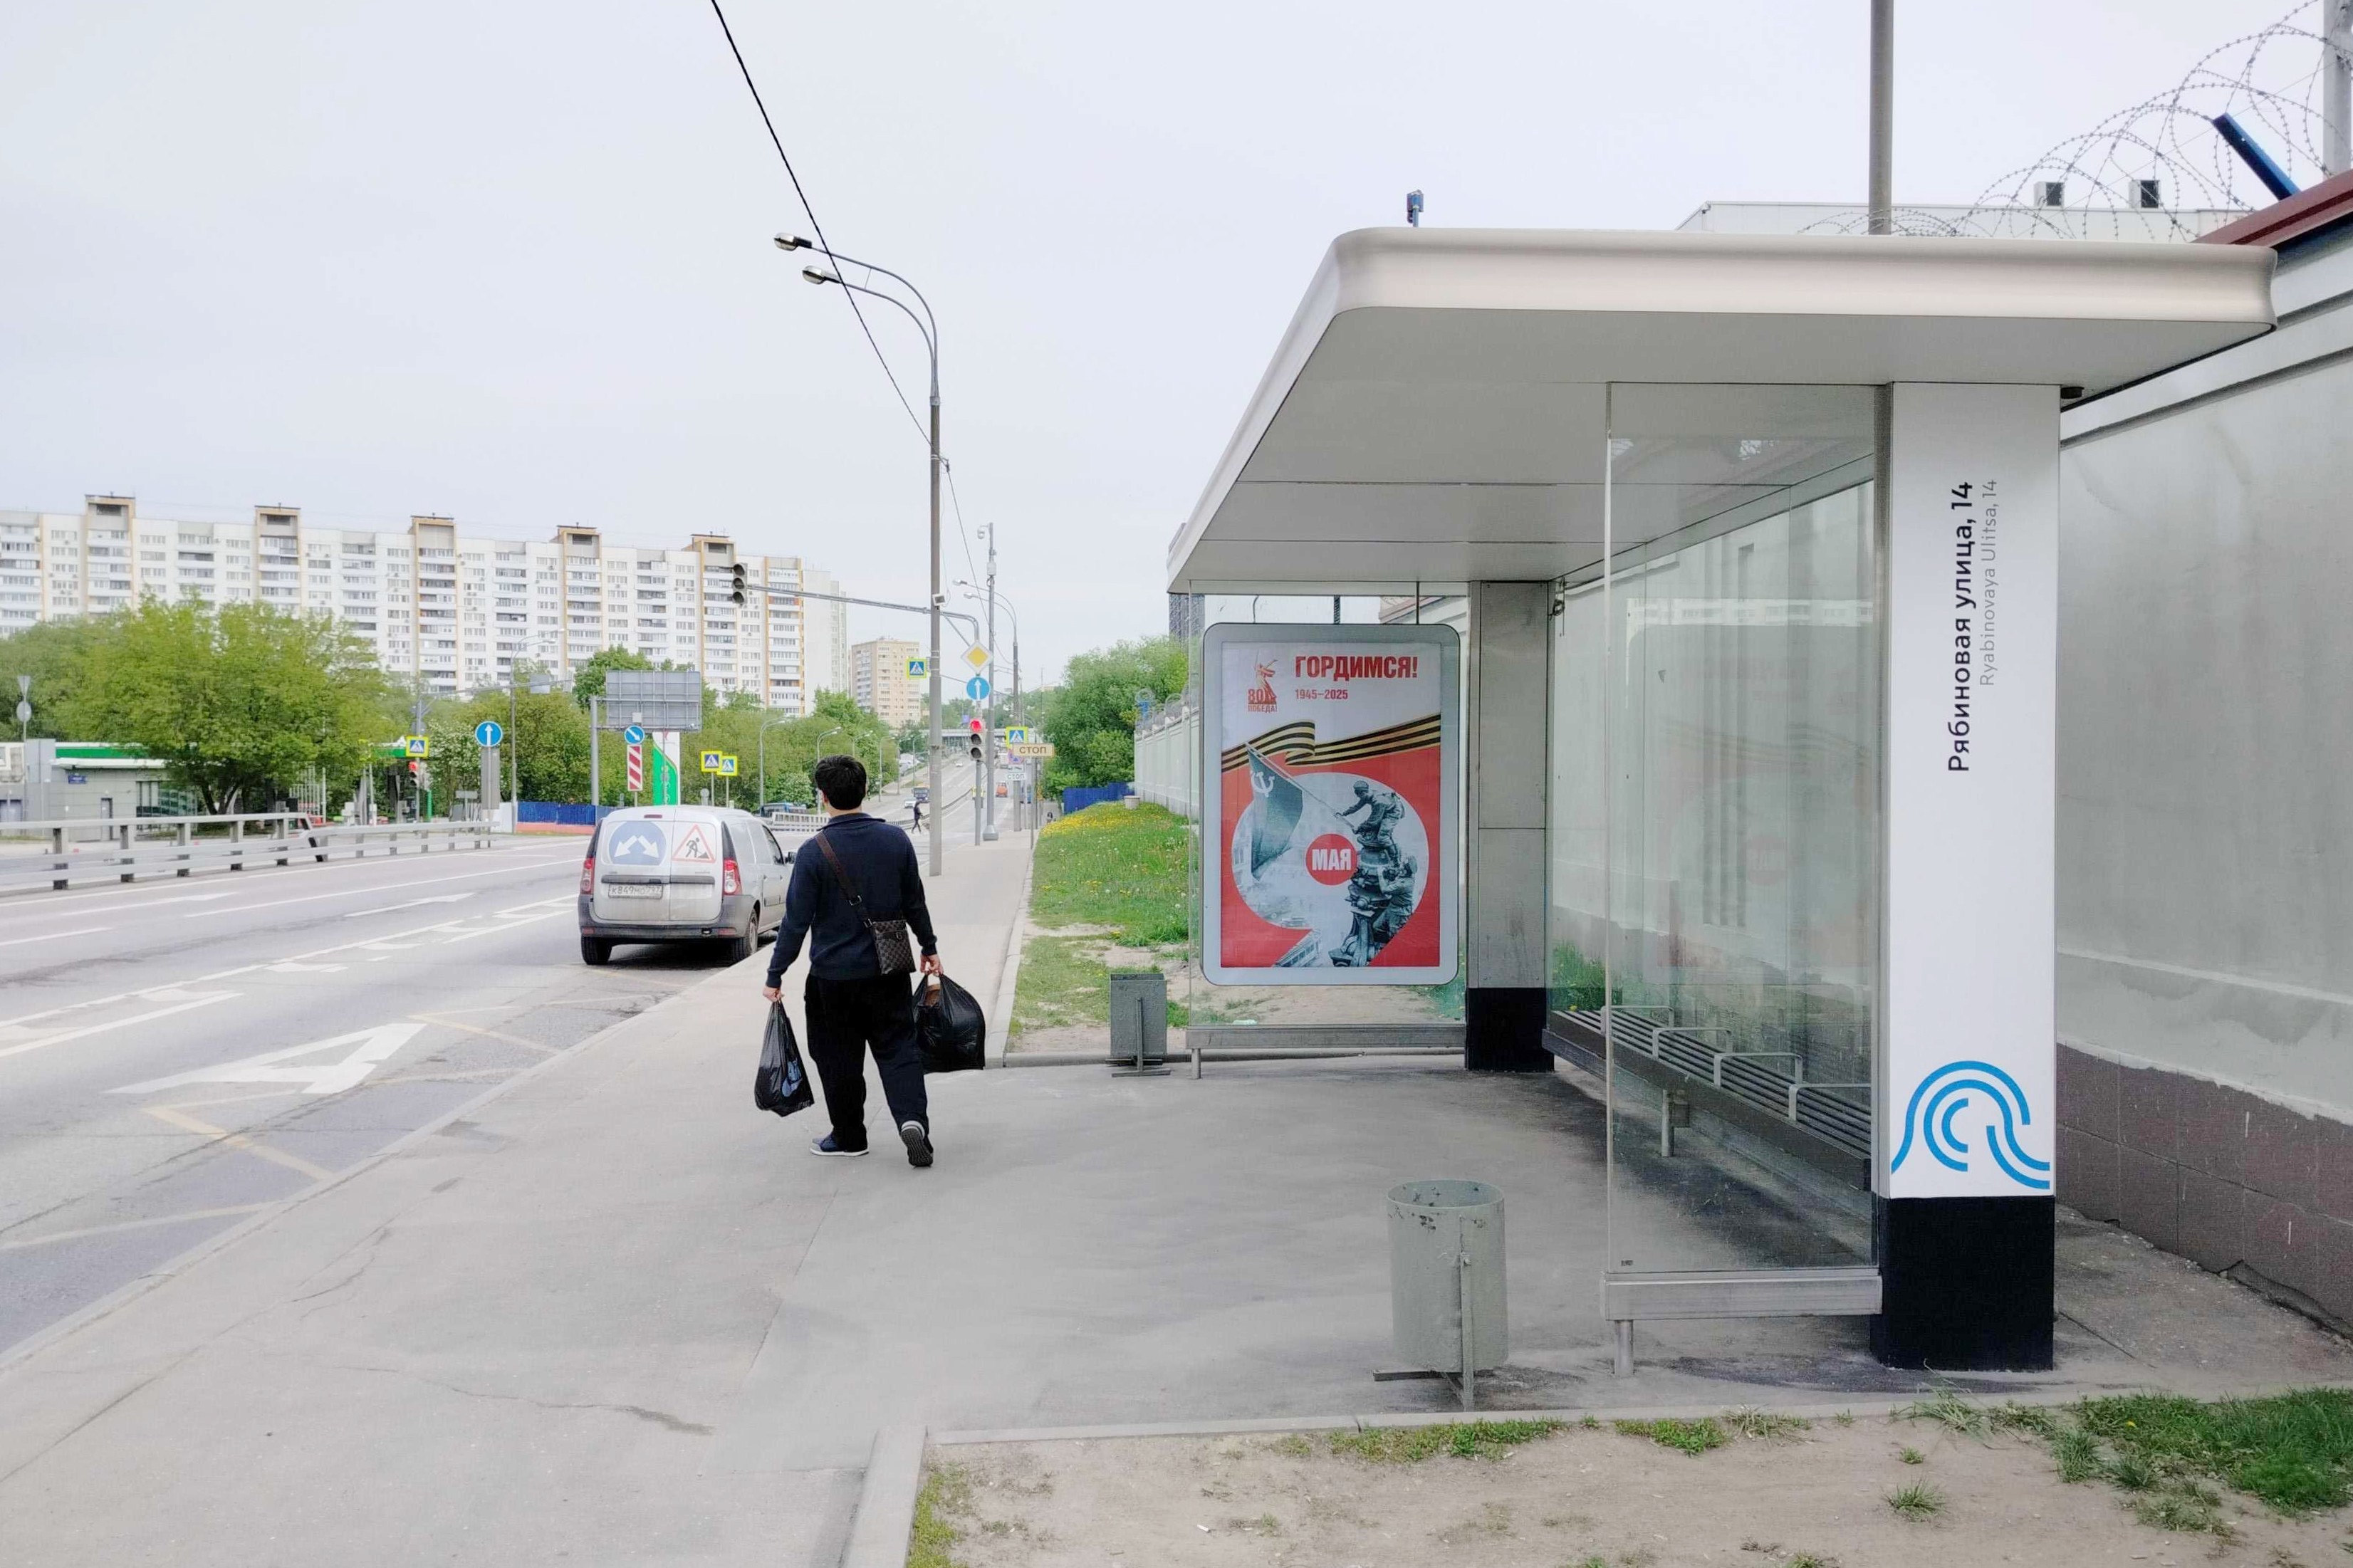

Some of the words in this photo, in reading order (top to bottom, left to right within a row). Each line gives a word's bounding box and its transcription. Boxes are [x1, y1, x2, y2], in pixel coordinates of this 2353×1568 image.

[1951, 481, 1973, 511] 14
[1982, 479, 1998, 498] 14
[1981, 503, 2000, 562] Ulitsa,
[1953, 518, 1977, 610] улица,
[1979, 568, 1999, 686] Ryabinovaya
[1295, 655, 1418, 681] ГОРДИМСЯ!
[1248, 704, 1278, 714] ПОБЕДА!
[1947, 617, 1971, 772] Рябиновая
[1312, 848, 1352, 871] МАЯ
